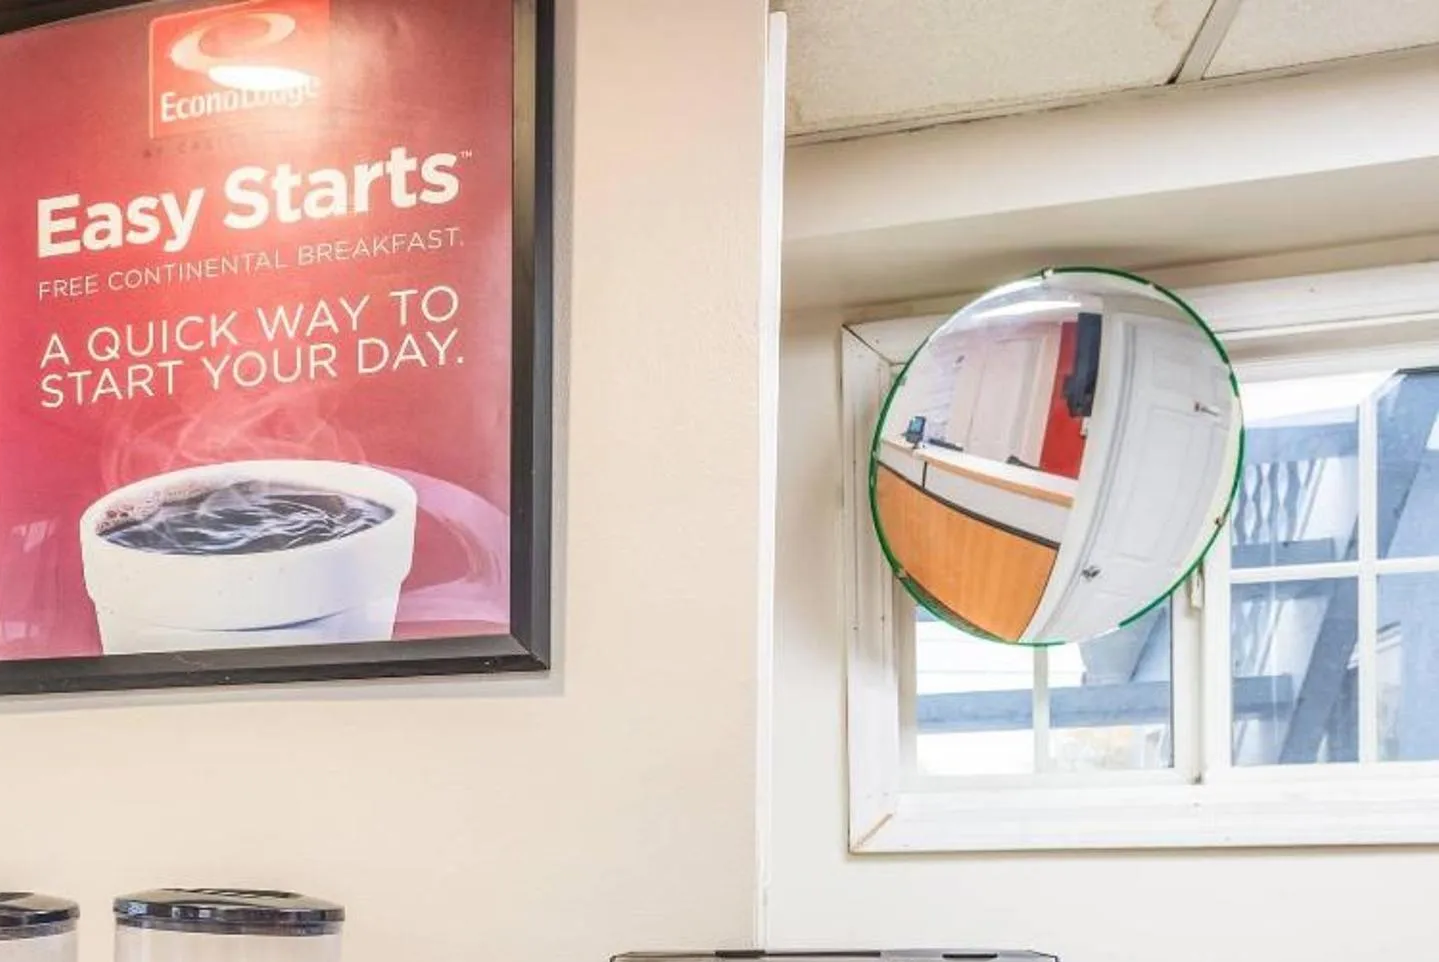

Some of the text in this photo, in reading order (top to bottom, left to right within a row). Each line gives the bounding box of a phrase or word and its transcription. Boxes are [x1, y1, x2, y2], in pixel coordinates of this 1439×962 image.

[37, 187, 204, 257] Easy
[40, 227, 464, 300] FREE CONTINENTAL BREAKFAST.
[41, 285, 458, 368] A QUICK WAY TO
[40, 330, 464, 408] START YOUR DAY.
